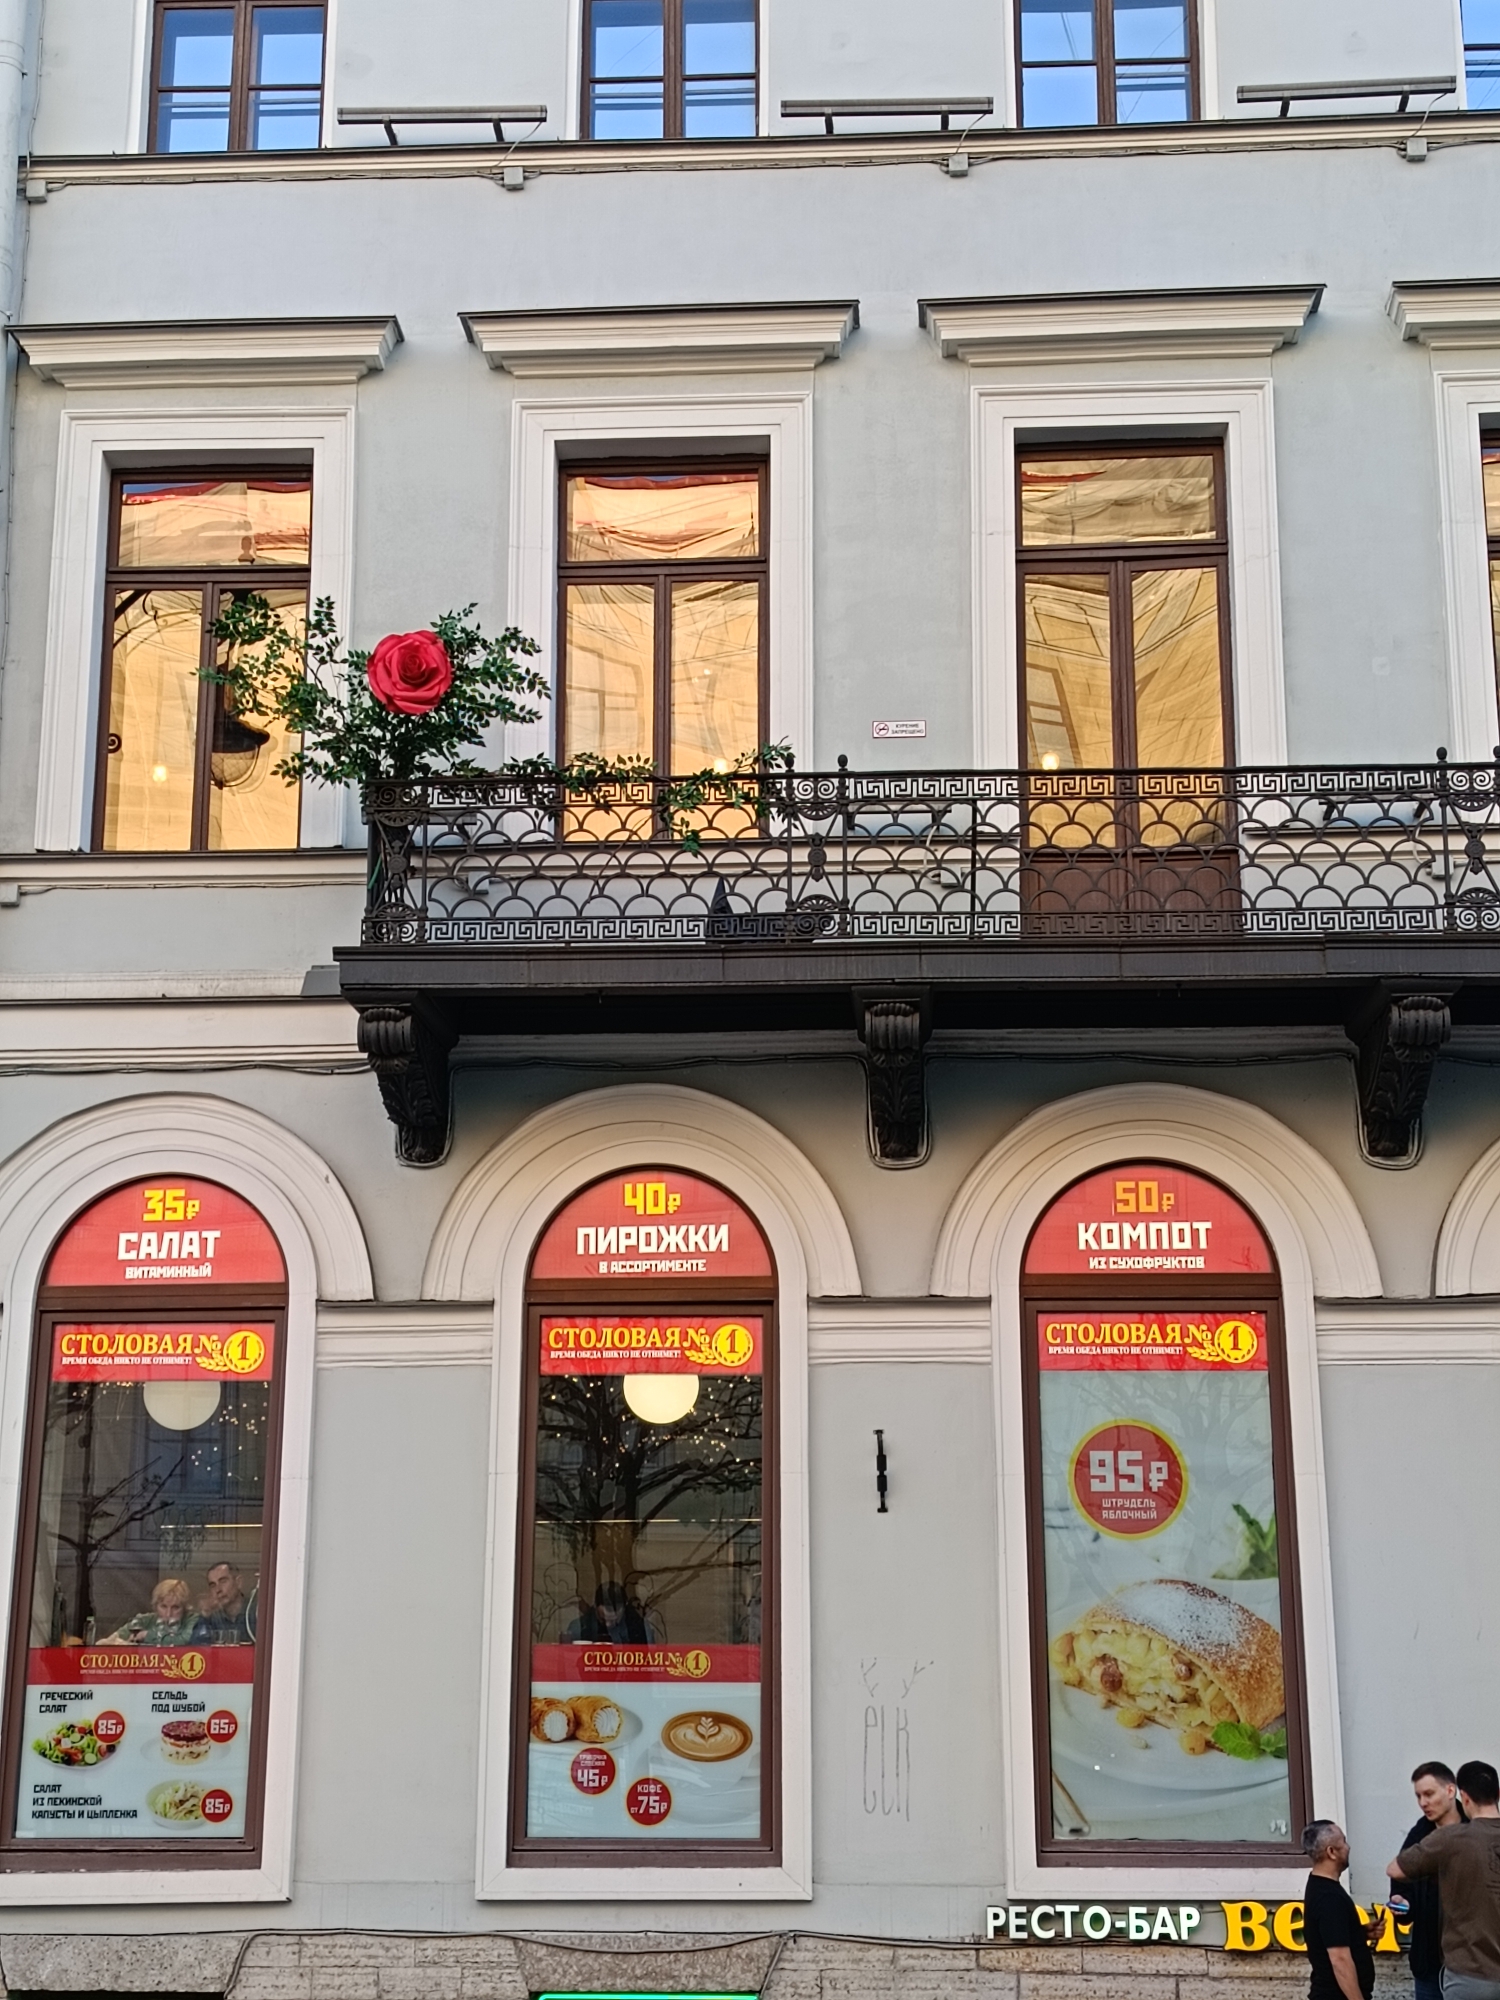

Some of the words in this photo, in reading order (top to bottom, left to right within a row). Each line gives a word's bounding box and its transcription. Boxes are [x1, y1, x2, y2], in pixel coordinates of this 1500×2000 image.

[143, 1188, 200, 1222] 35₽
[624, 1182, 681, 1215] 40₽
[577, 1224, 729, 1255] ПИРОЖКИ
[1077, 1221, 1212, 1250] КОМПОТ
[117, 1230, 221, 1260] САЛАТ
[598, 1261, 608, 1273] В
[610, 1259, 707, 1273] АССОРТИМЕНТЕ
[1089, 1257, 1106, 1269] ИЗ
[1109, 1256, 1205, 1269] СУХОФРУКТОВ
[125, 1262, 212, 1279] ВИТАМИННЫЙ
[549, 1328, 682, 1348] СТОЛОВАЯ
[1046, 1323, 1181, 1344] СТОЛОВАЯ
[61, 1333, 194, 1354] СТОЛОВАЯ
[1089, 1450, 1169, 1492] 95₽
[1102, 1498, 1156, 1508] ШТРУДЕЛЬ
[1102, 1508, 1157, 1519] ЯБЛОЧНЫЙ
[80, 1654, 159, 1668] СТОЛОВАЯ
[584, 1651, 663, 1665] СТОЛОВАЯ
[40, 1690, 93, 1700] ГРЕЧЕСКИЙ
[152, 1691, 188, 1700] СЕЛЬДЬ
[39, 1704, 68, 1713] САЛАТ
[151, 1704, 170, 1713] ПОД
[172, 1701, 205, 1712] ШУБОЙ
[33, 1784, 62, 1793] САЛАТ
[637, 1784, 662, 1793] КОФЕ
[33, 1797, 45, 1806] ИЗ
[47, 1795, 102, 1806] ПЕКИНСКОЙ
[32, 1810, 75, 1819] КАПУСТЫ
[78, 1810, 84, 1818] И
[87, 1810, 138, 1819] ЦЫПЛЕНКА
[986, 1904, 1201, 1941] РЕСТО-БАР
